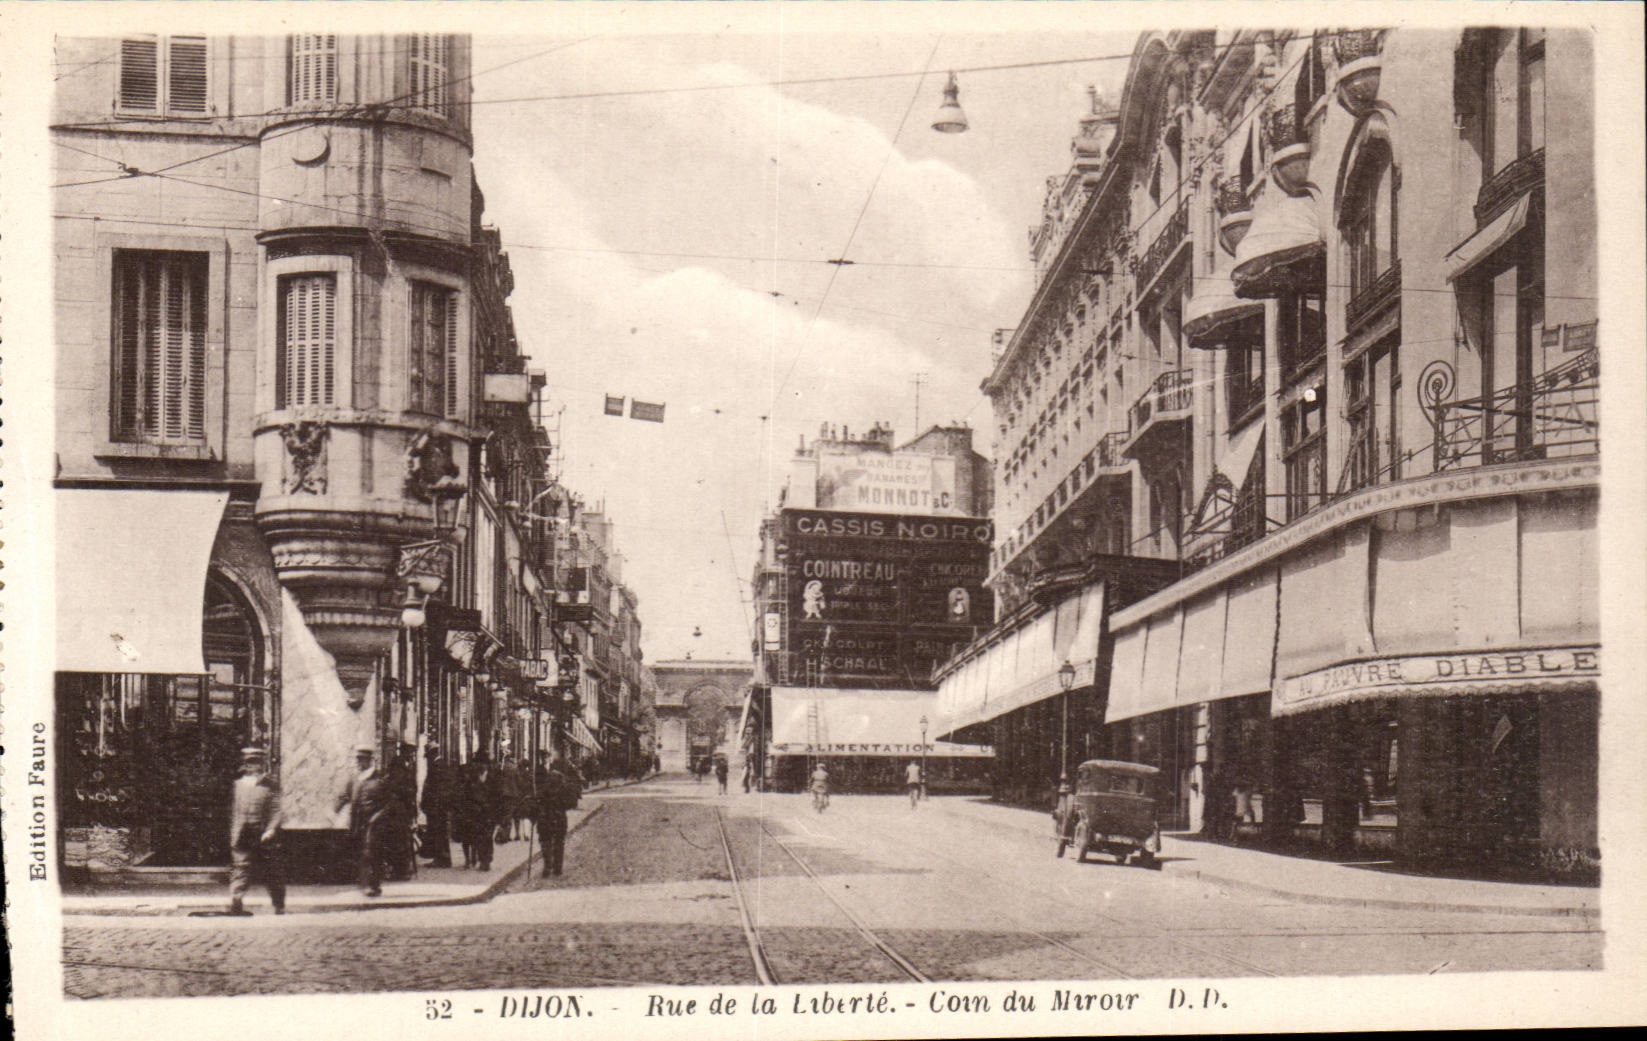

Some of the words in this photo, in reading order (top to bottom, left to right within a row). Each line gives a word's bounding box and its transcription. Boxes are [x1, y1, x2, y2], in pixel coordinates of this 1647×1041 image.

[858, 485, 930, 507] MONNOT
[797, 517, 884, 536] CASSIS
[803, 560, 895, 580] COINTREAU
[519, 660, 548, 678] TABAC
[1323, 663, 1403, 690] PAUVRE
[1436, 651, 1599, 678] DIABLE
[805, 743, 935, 753] ALIMENTATION
